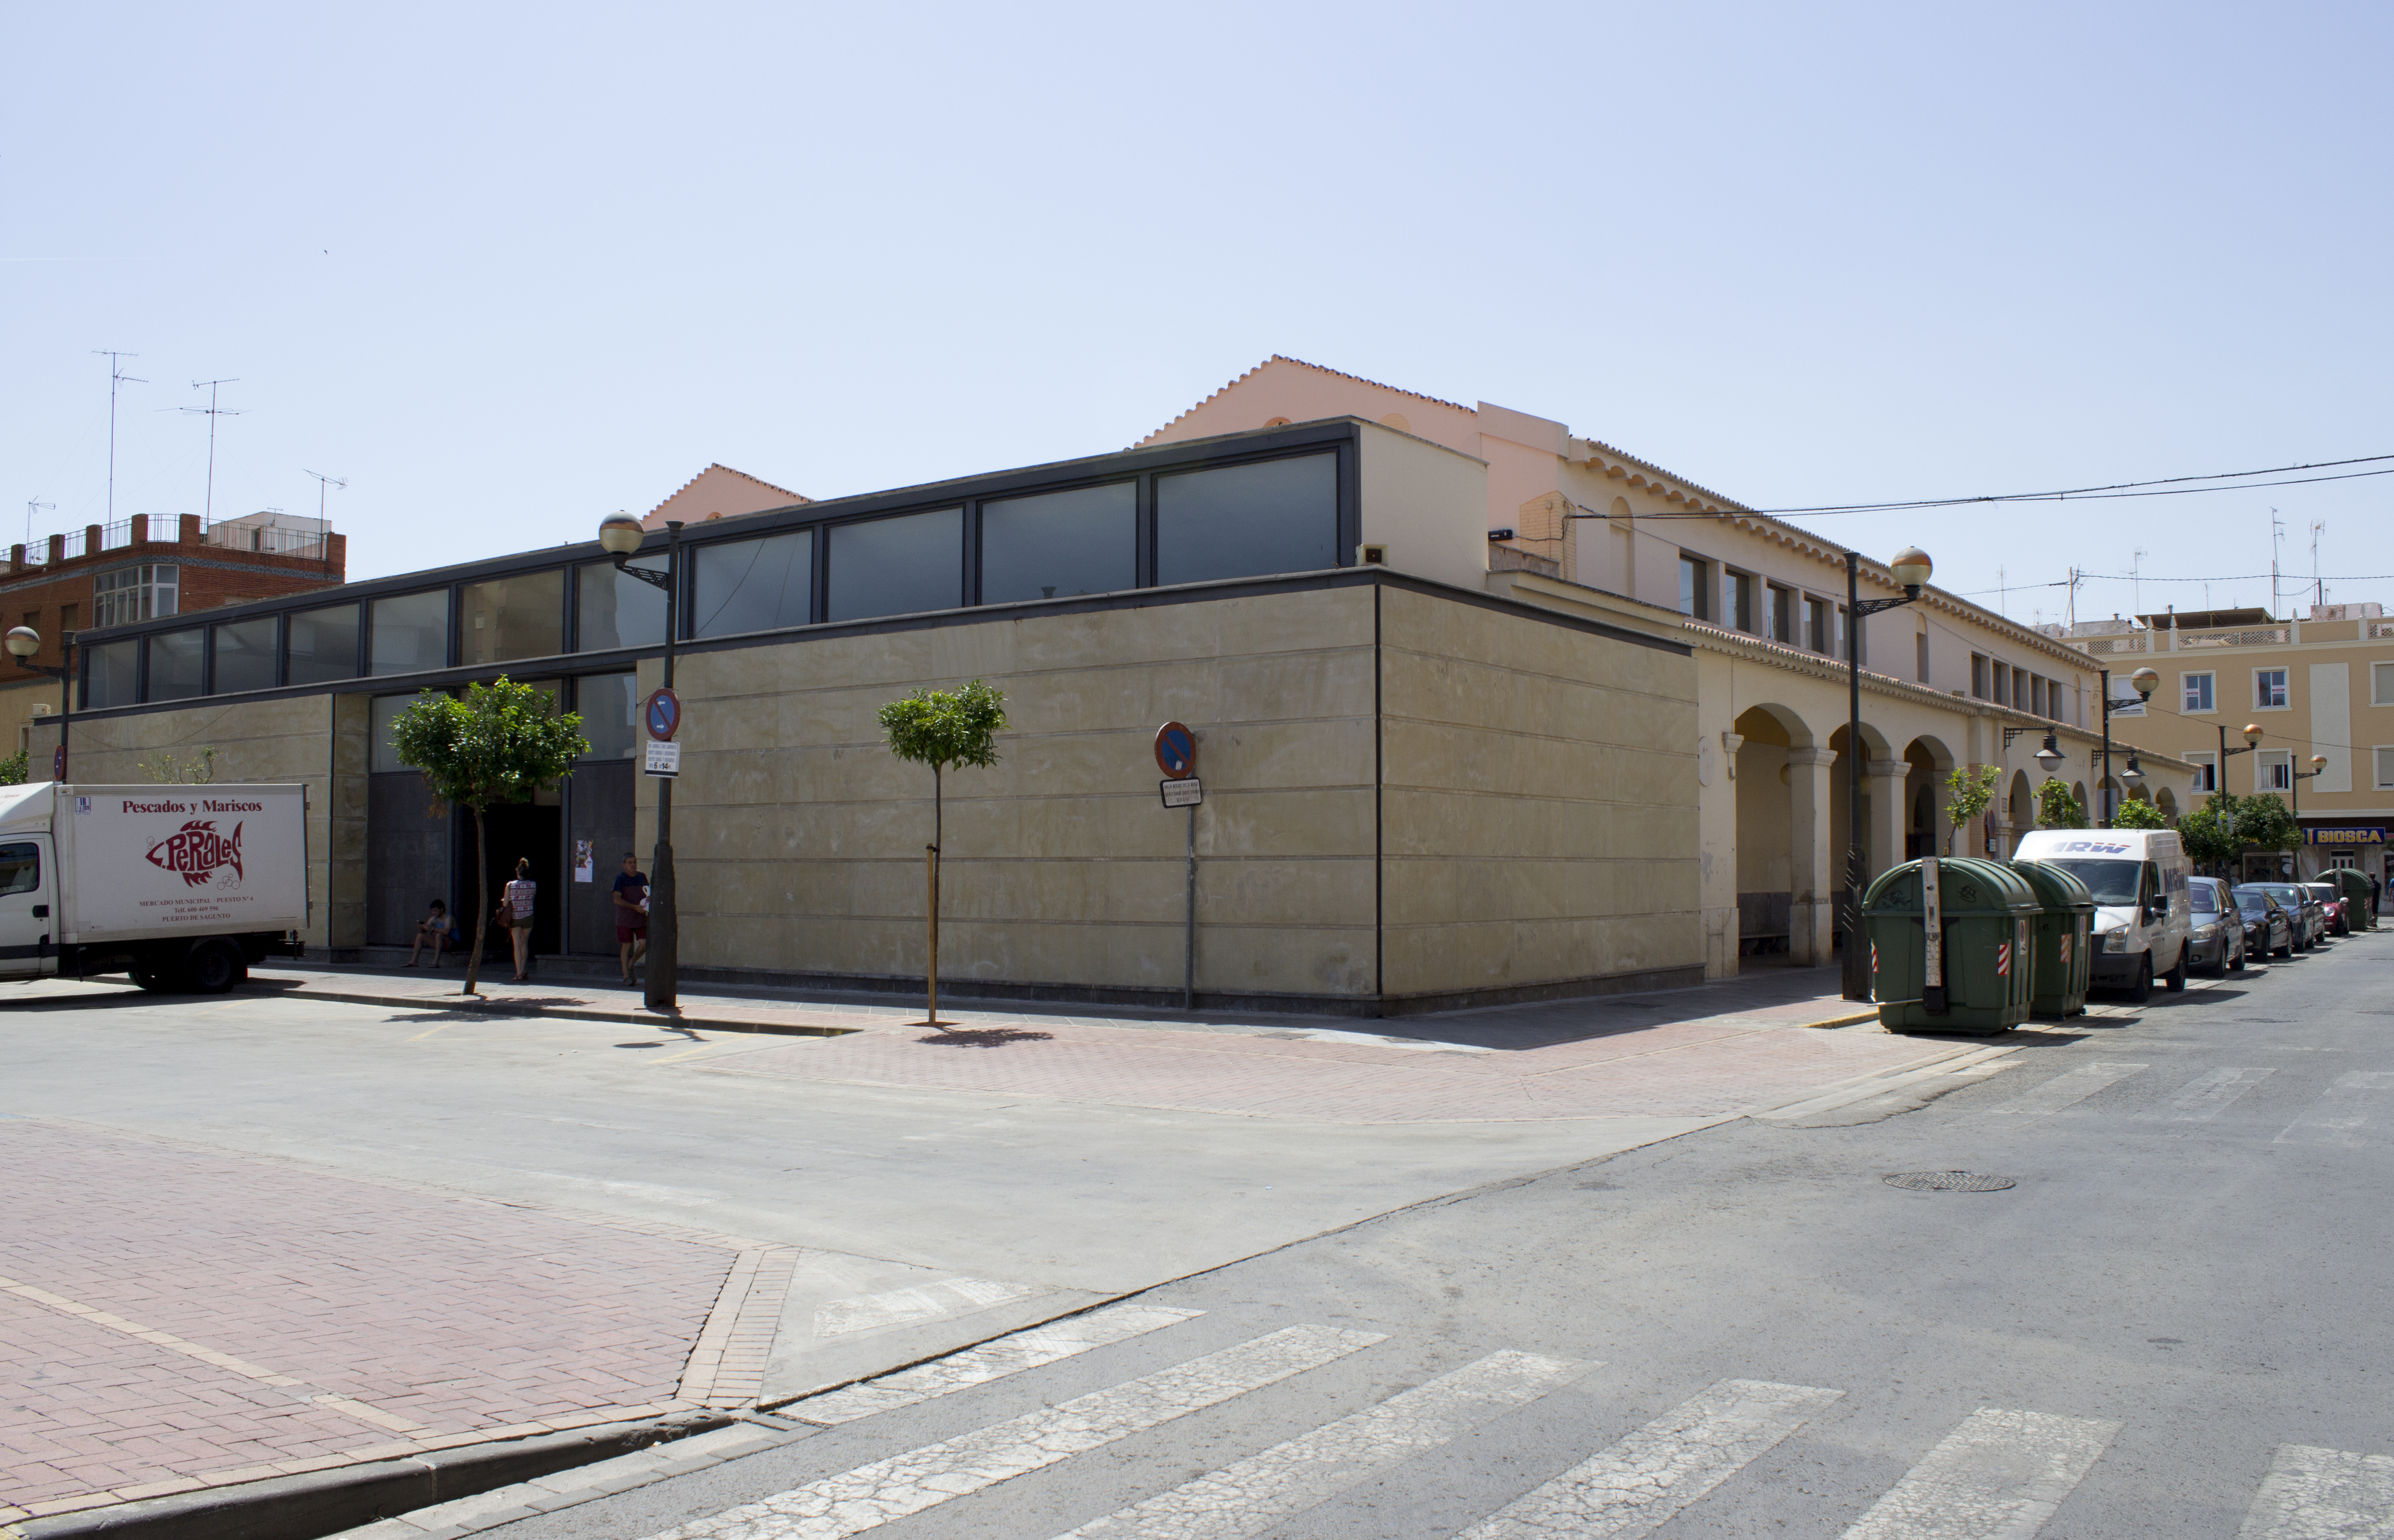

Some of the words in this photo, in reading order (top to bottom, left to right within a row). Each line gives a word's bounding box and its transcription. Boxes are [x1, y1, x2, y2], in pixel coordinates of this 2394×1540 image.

[123, 800, 186, 813] Pescados
[189, 803, 197, 815] y
[202, 799, 262, 812] Mariscos
[2317, 830, 2382, 843] BIOSCA
[2046, 841, 2132, 854] MRW
[2163, 866, 2186, 893] MRW
